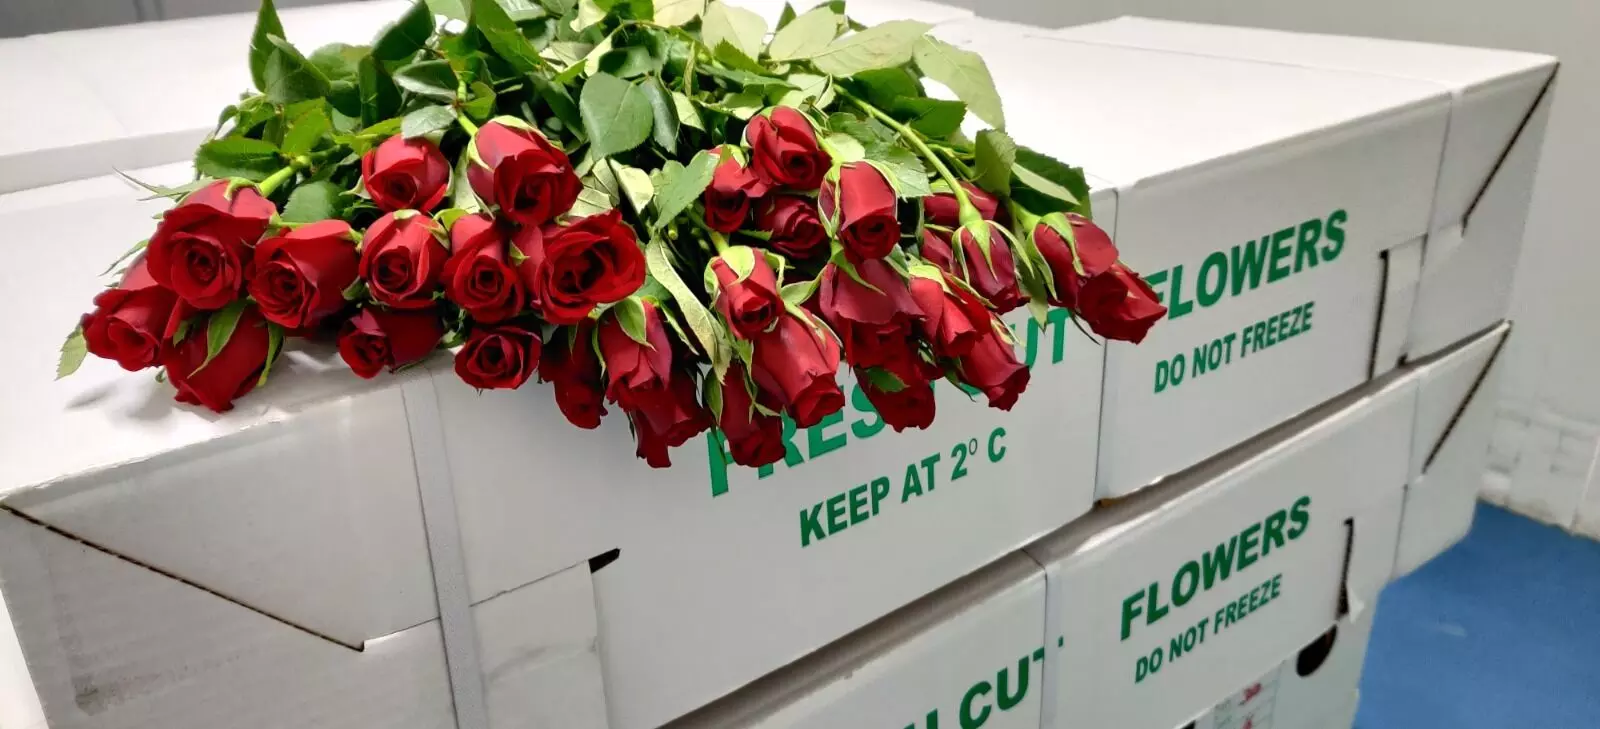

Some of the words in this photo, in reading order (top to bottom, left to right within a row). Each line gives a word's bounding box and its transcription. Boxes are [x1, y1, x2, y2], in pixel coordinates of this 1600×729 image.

[1154, 353, 1186, 394] DO
[1191, 332, 1237, 378] NOT
[1240, 301, 1315, 358] FREEZE
[706, 379, 936, 498] FRES
[799, 475, 891, 548] KEEP
[900, 452, 942, 503] AT
[986, 426, 1007, 463] C
[1120, 495, 1311, 642] FLOWERS
[959, 634, 1064, 729] CU
[1134, 647, 1164, 684] DO
[1168, 617, 1209, 662] NOT
[1213, 573, 1283, 635] FREEZE
